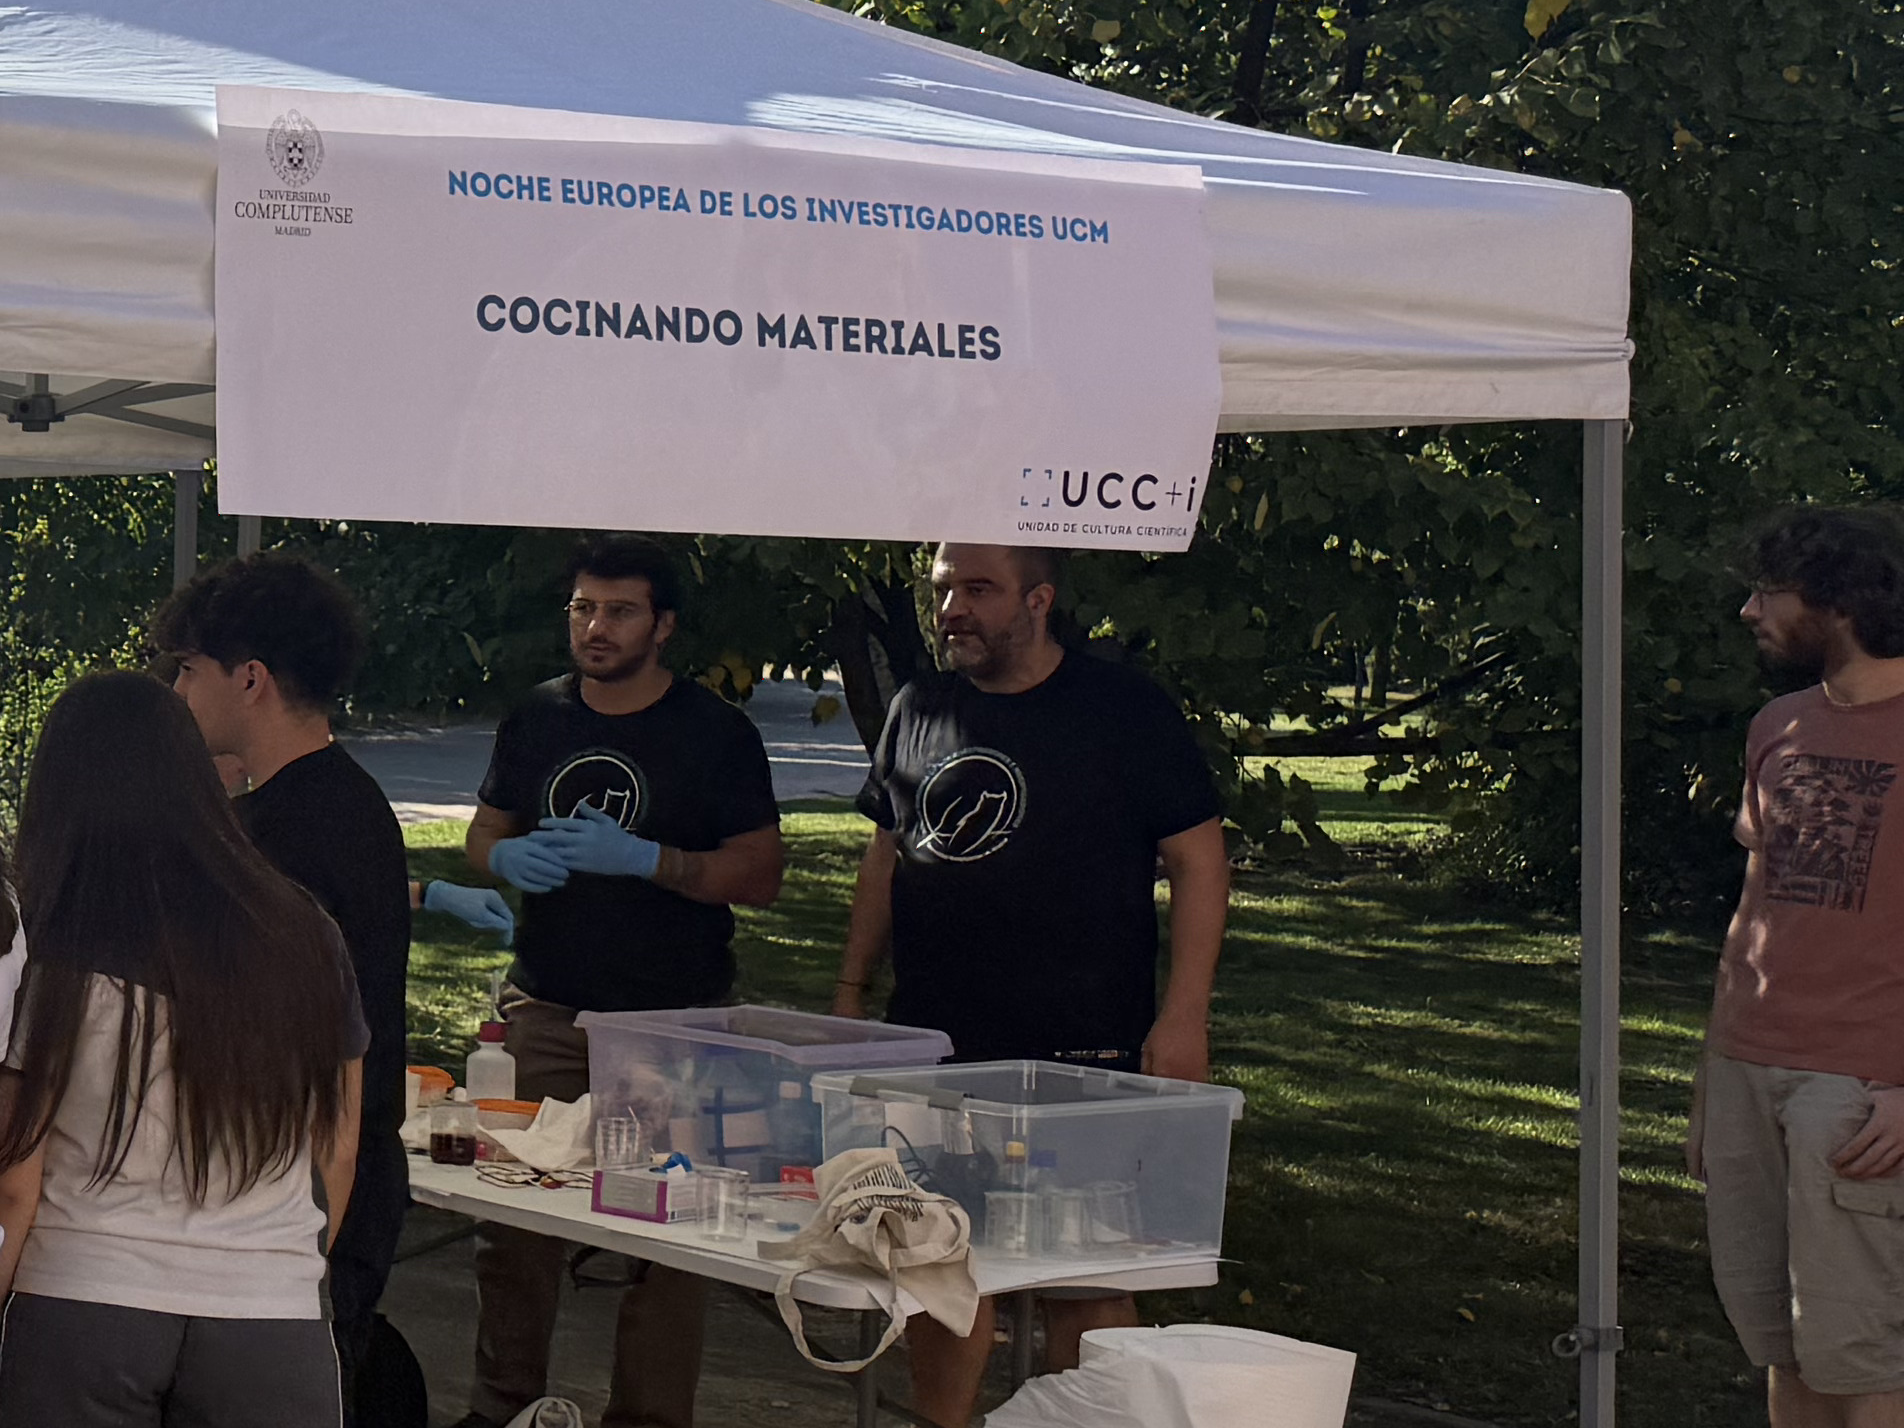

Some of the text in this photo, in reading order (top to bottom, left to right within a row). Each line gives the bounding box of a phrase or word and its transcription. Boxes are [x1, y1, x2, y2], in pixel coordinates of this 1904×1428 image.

[259, 189, 331, 203] UNIVERSIDAD
[448, 169, 1110, 245] NOCHE EUROPEA DE LOS INVESTIGADORES UCM
[234, 201, 354, 224] COMPLUTENSE
[274, 225, 312, 237] MADRID
[475, 293, 1003, 361] COCINANDO MATERIALES
[1061, 470, 1197, 512] UCC+i
[1017, 521, 1059, 532] UNIDAD
[1063, 524, 1077, 533] DE
[1082, 524, 1132, 535] CULTURA
